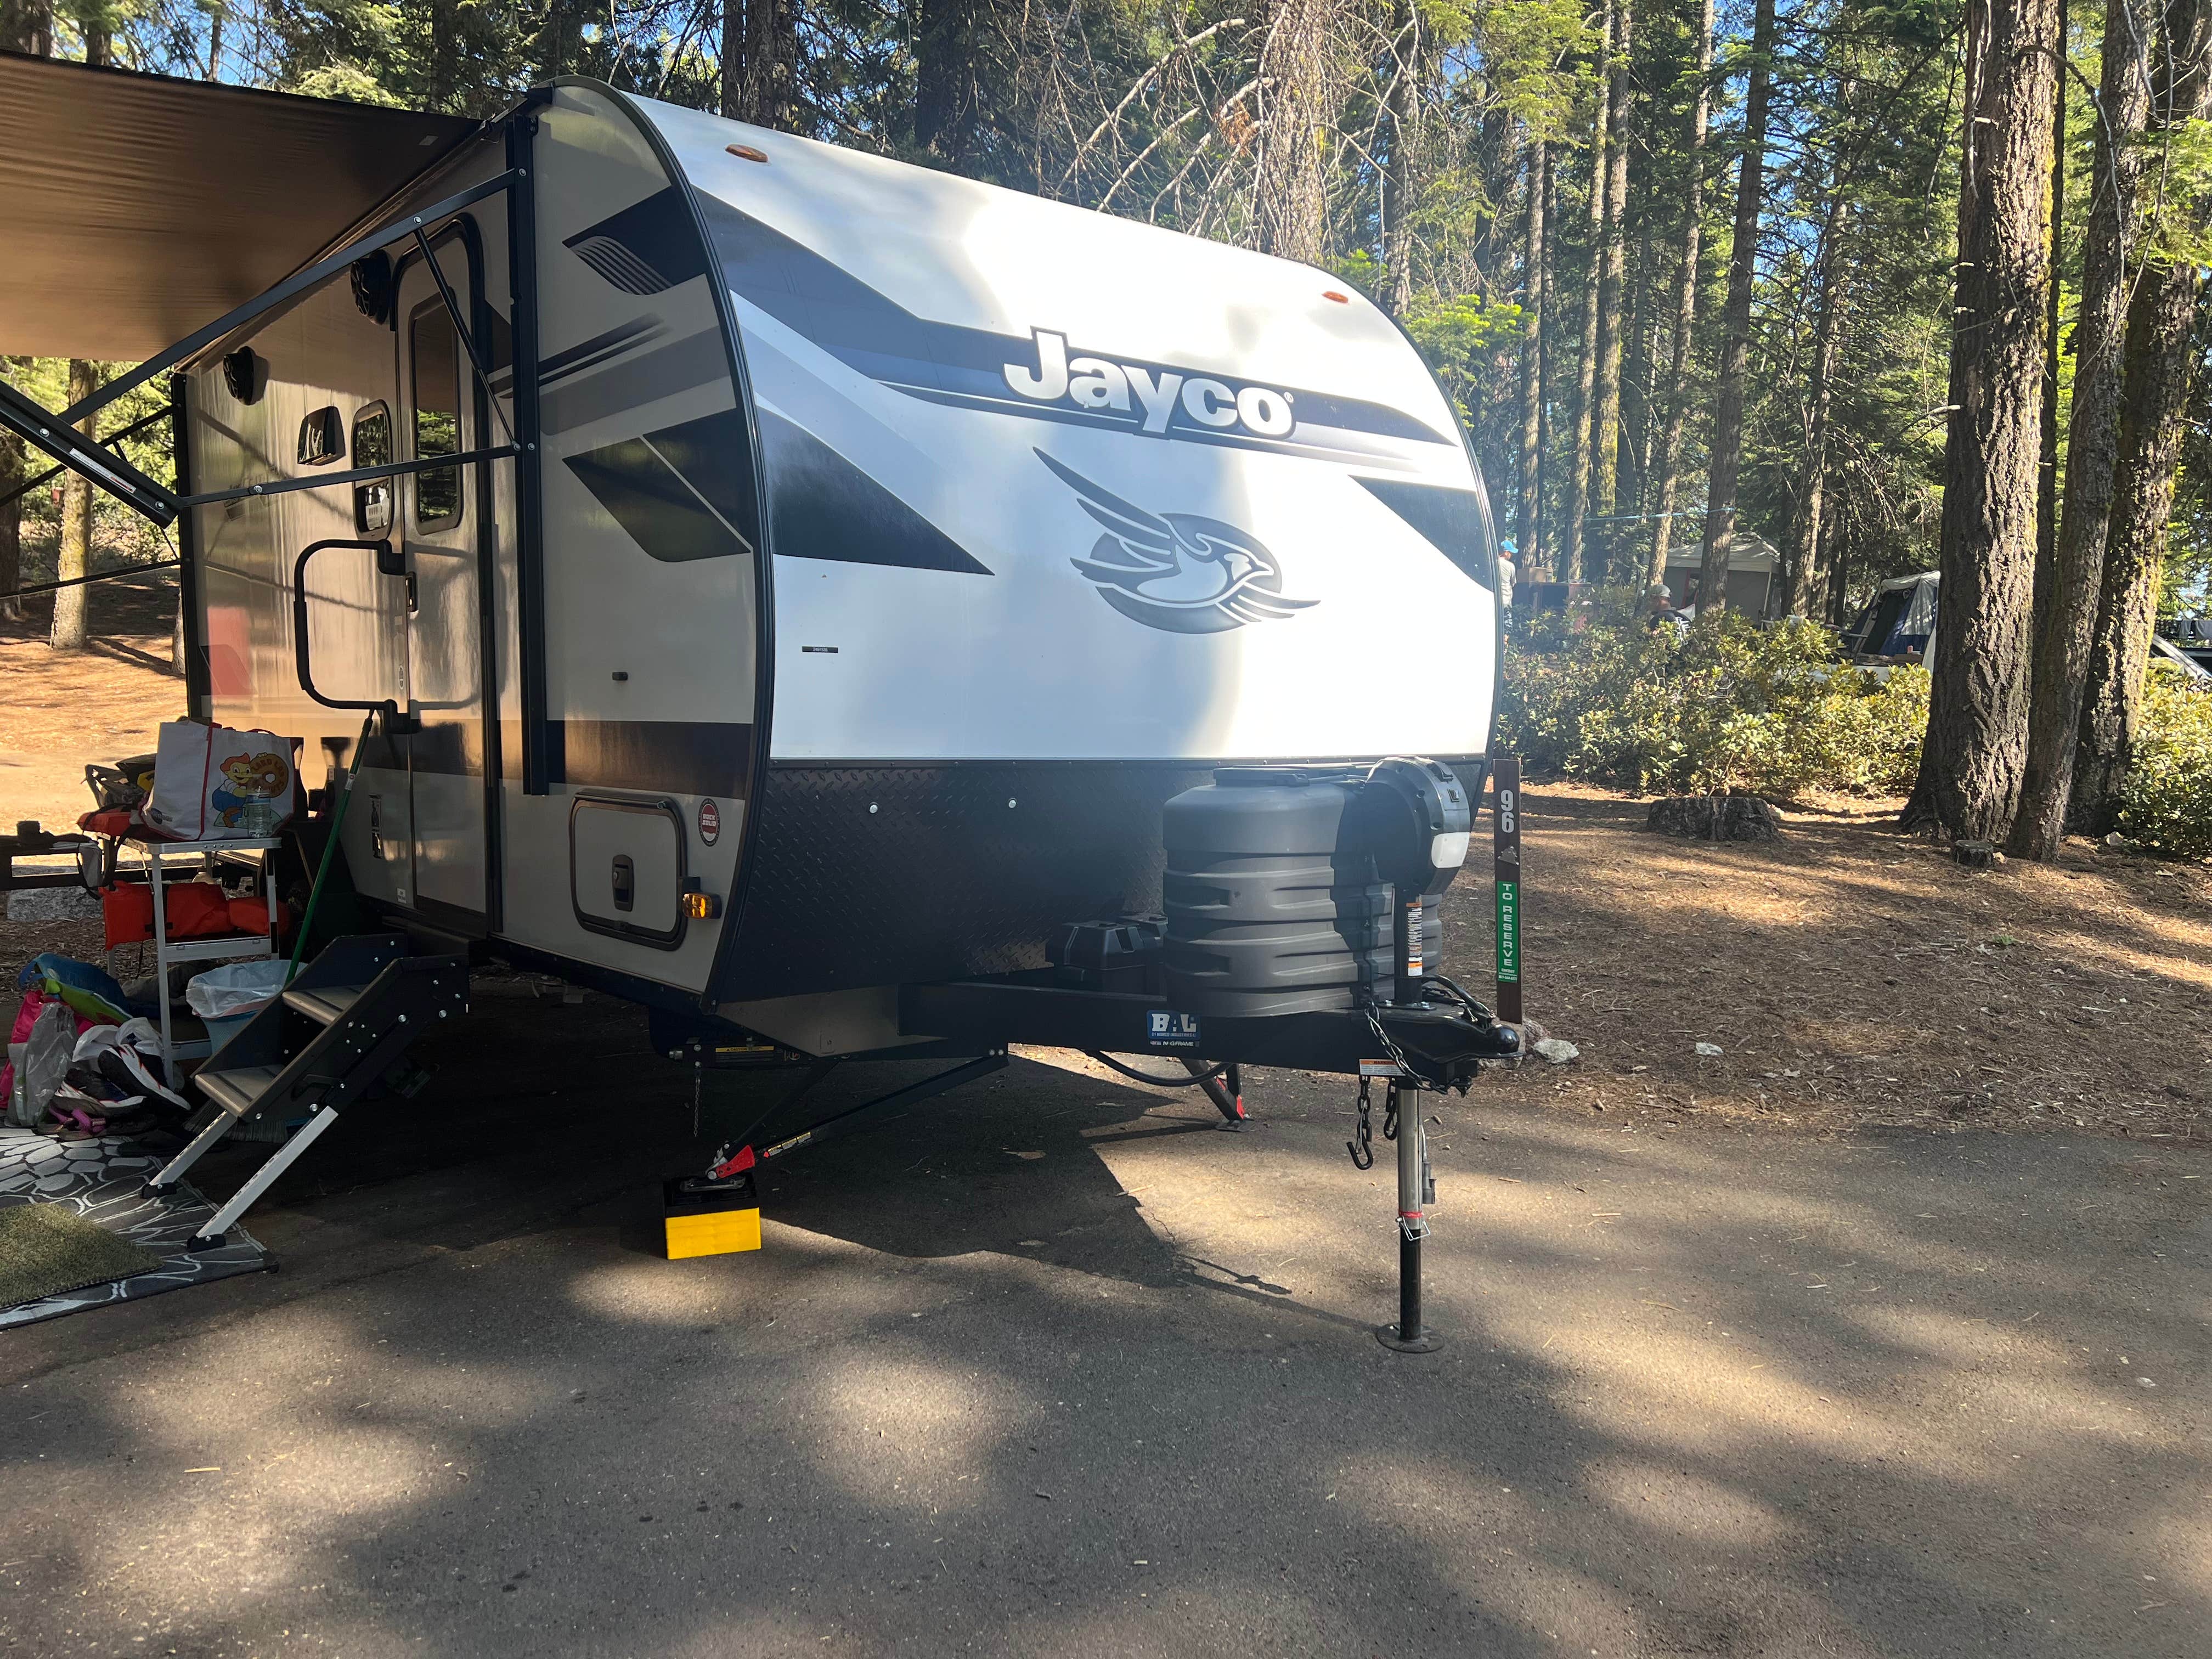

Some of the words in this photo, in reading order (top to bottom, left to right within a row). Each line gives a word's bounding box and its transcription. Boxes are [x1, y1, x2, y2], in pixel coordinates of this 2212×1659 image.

[1003, 330, 1293, 435] Jayco
[1500, 789, 1514, 833] 96
[1502, 883, 1513, 900] TO
[1503, 905, 1513, 967] RESERVE
[1152, 1013, 1197, 1032] BAL
